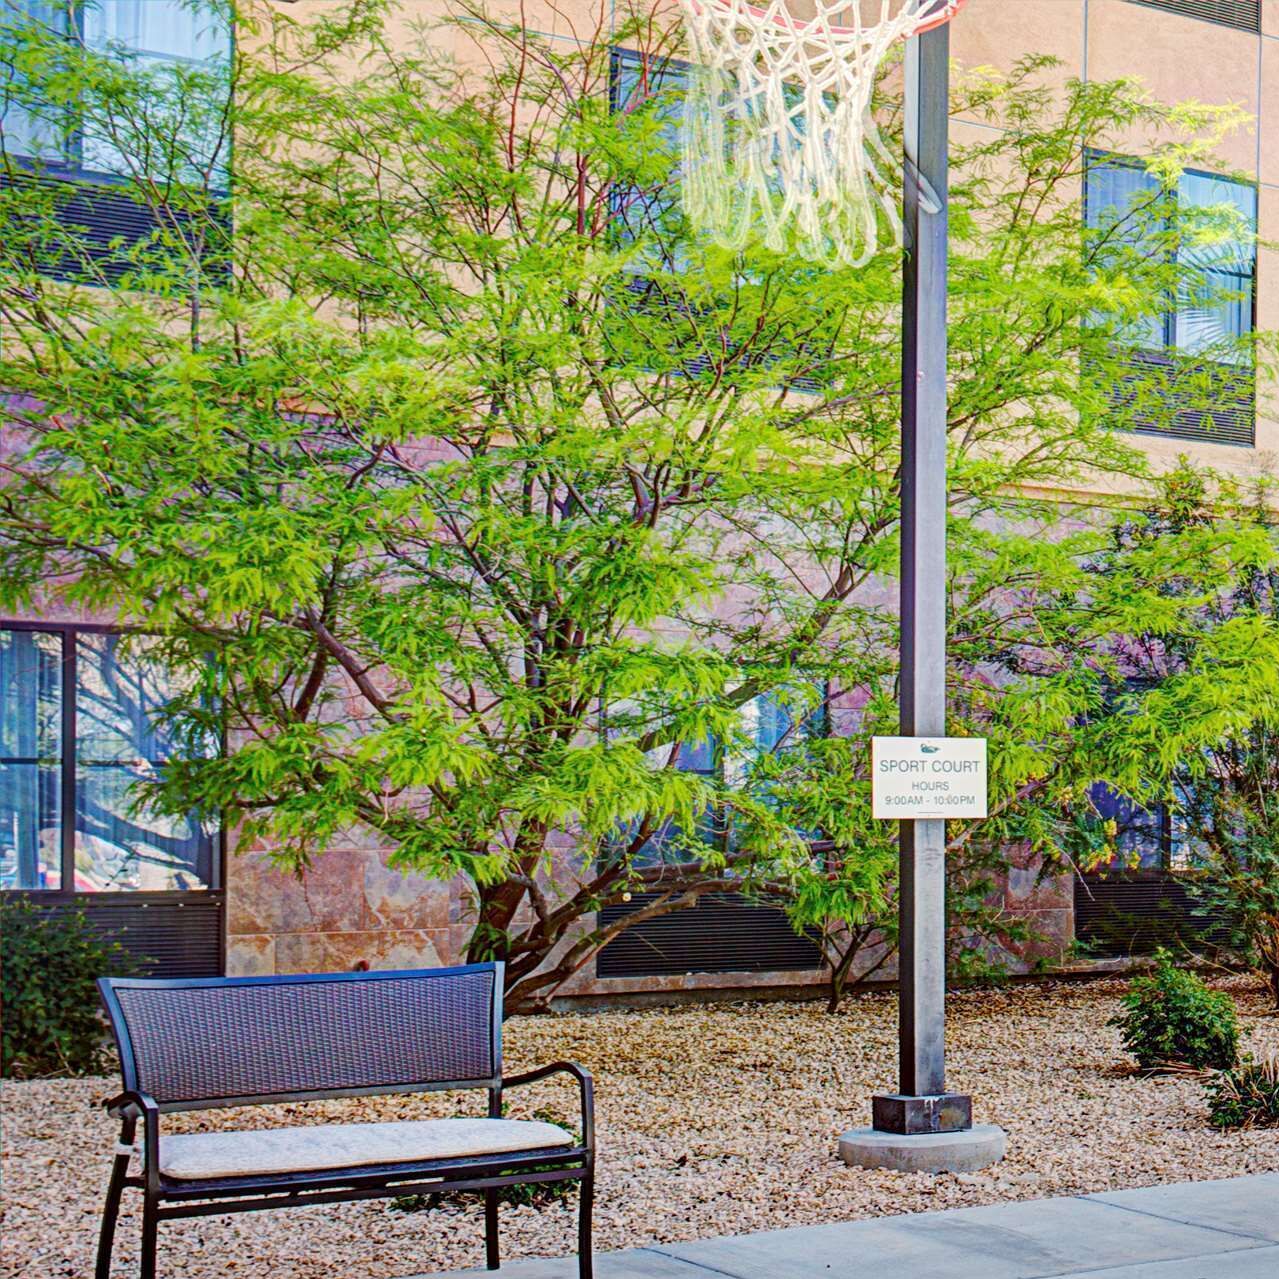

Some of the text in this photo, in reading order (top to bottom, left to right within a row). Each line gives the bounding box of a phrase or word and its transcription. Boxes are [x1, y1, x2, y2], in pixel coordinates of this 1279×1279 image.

[880, 760, 980, 773] SPORT COURT
[911, 781, 950, 791] HOURS
[885, 796, 923, 805] 9:00AM
[934, 796, 975, 805] 10:00PM
